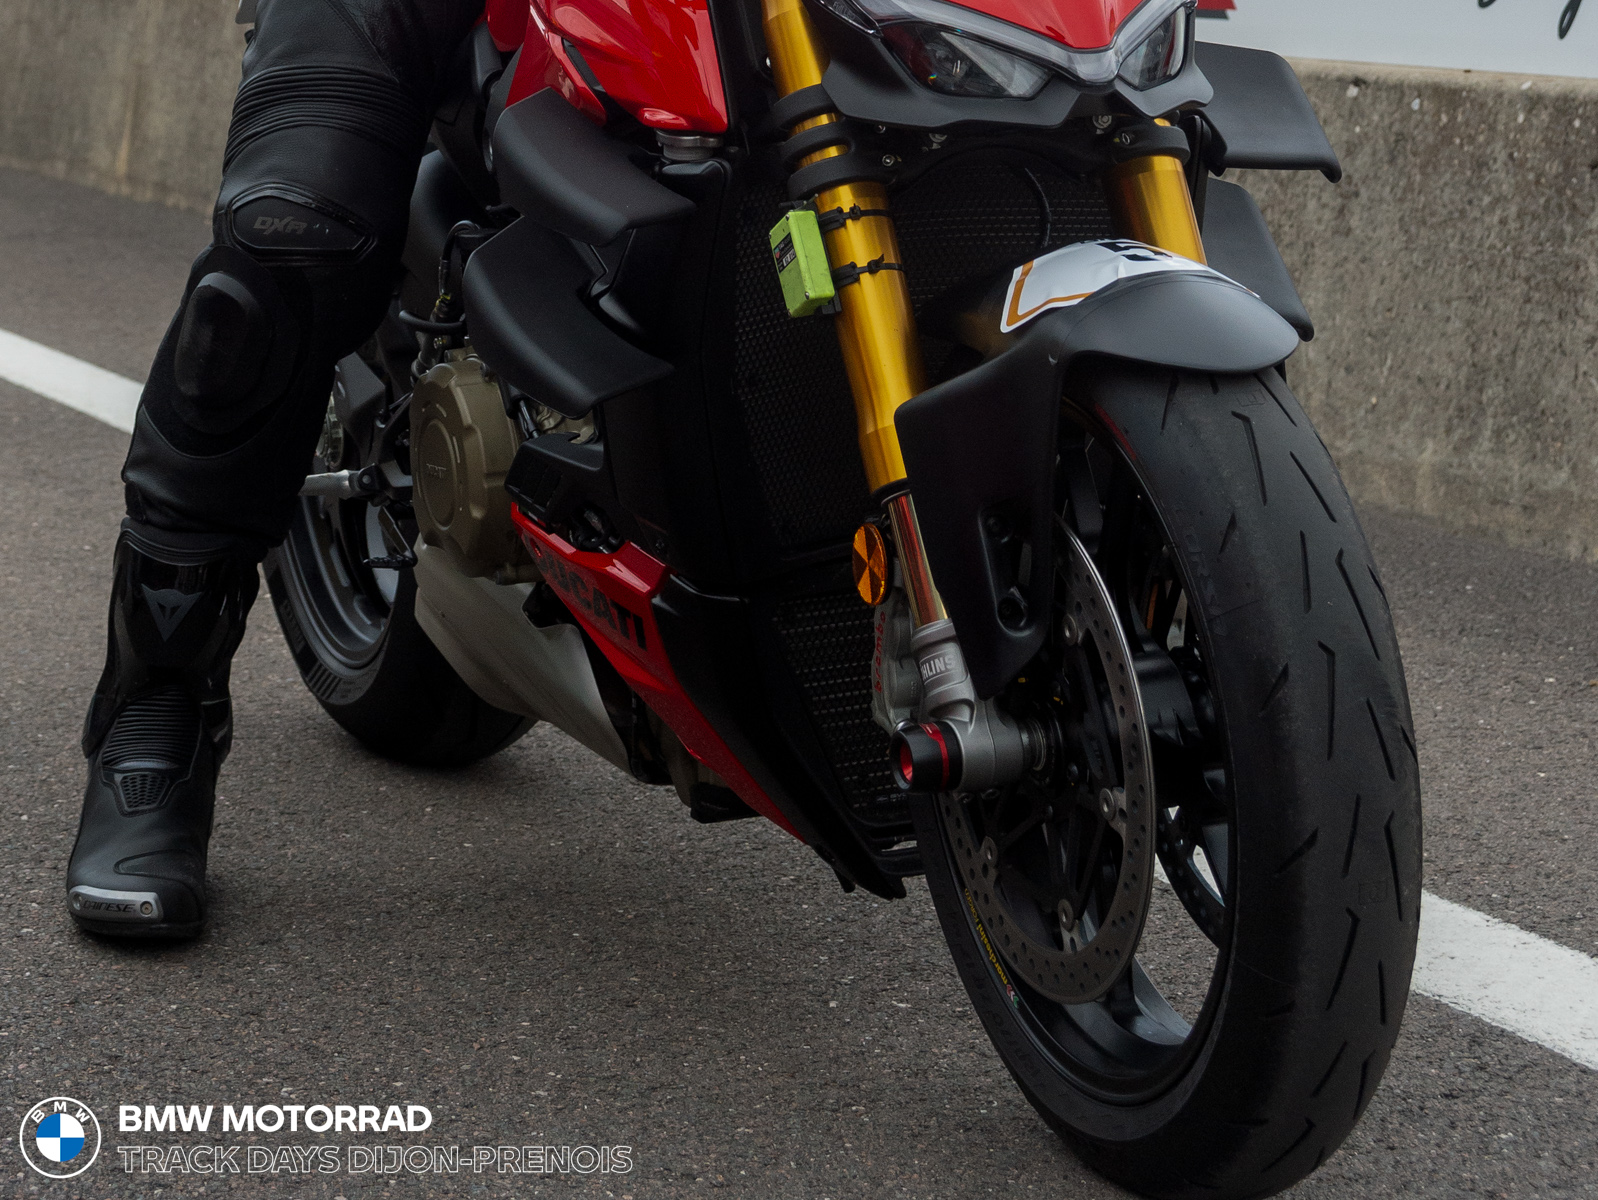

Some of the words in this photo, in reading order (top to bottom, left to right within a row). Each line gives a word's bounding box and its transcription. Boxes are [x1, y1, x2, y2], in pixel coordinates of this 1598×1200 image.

[253, 216, 308, 236] DXR
[874, 611, 887, 694] brembo
[921, 655, 957, 681] HLINS
[976, 923, 1009, 985] marchesini
